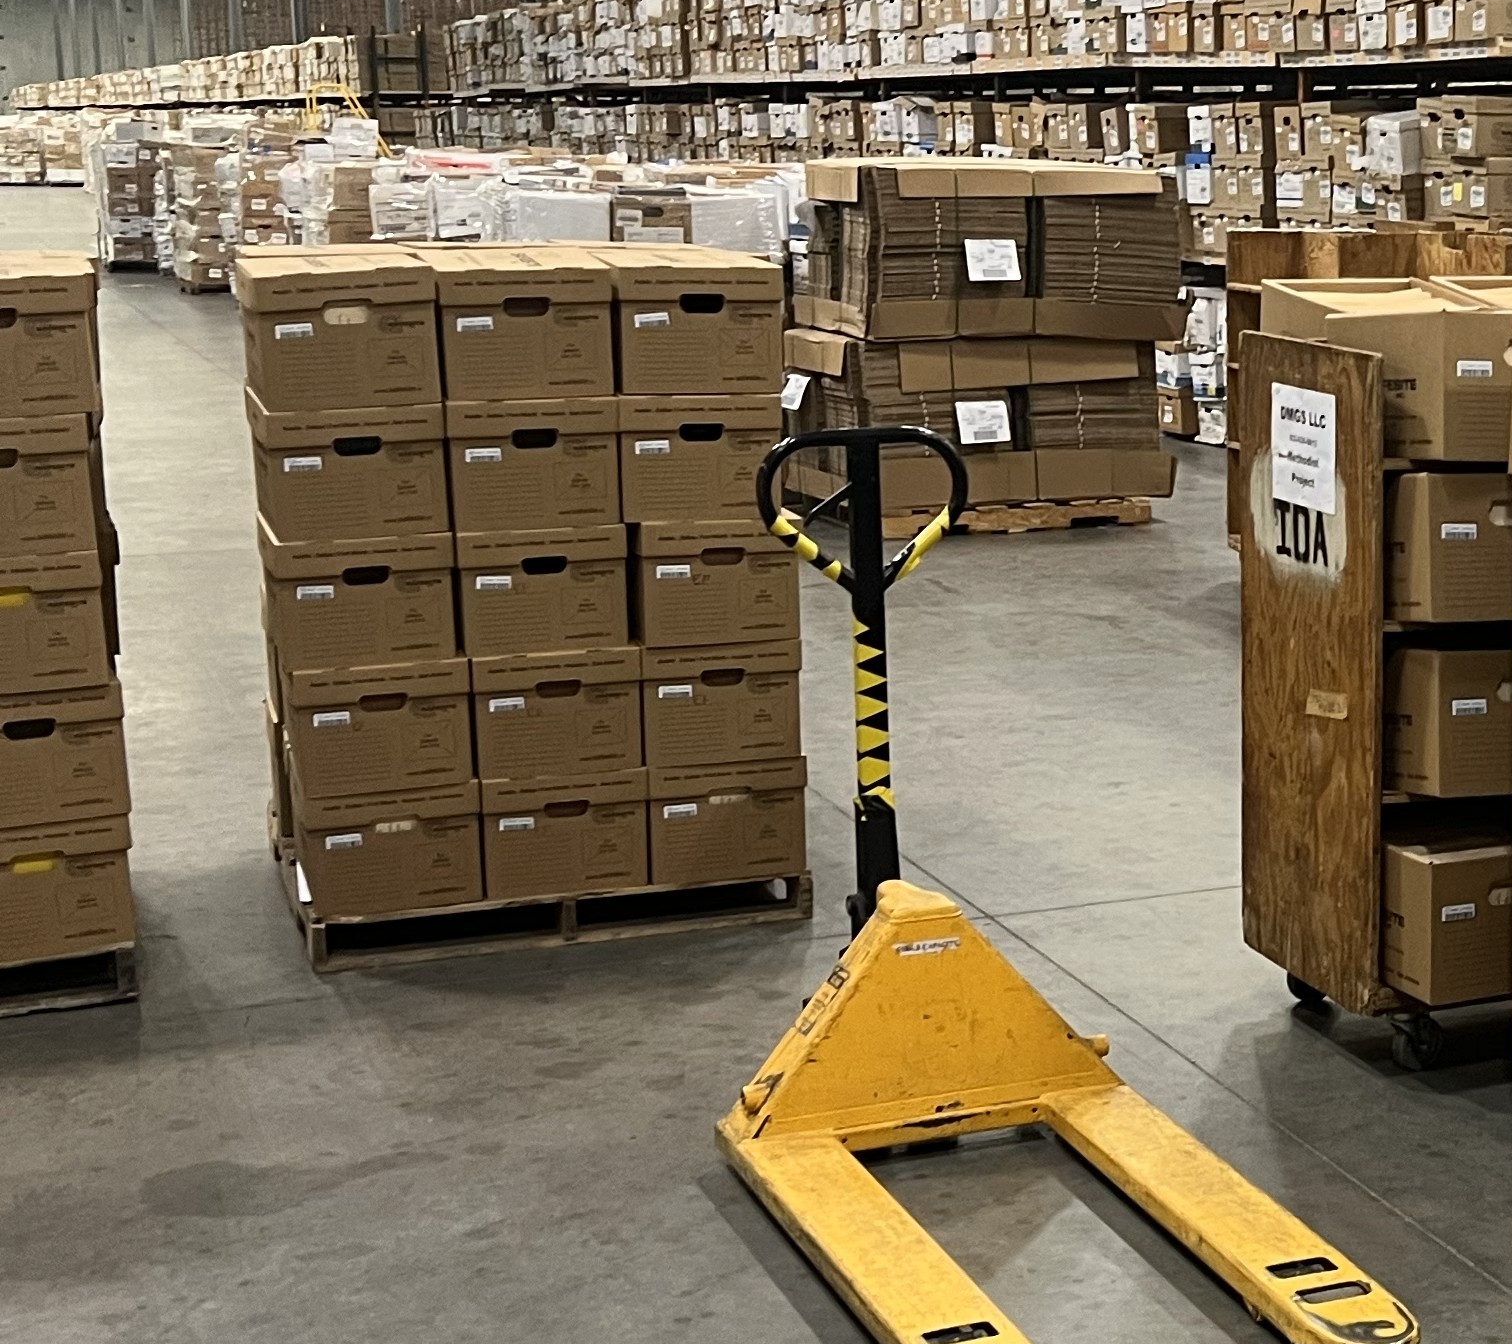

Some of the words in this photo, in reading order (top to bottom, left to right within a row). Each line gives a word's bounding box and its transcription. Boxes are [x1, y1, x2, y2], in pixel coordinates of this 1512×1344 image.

[1280, 406, 1307, 425] DMGS
[1309, 411, 1327, 429] LLC
[1273, 498, 1329, 567] IDA
